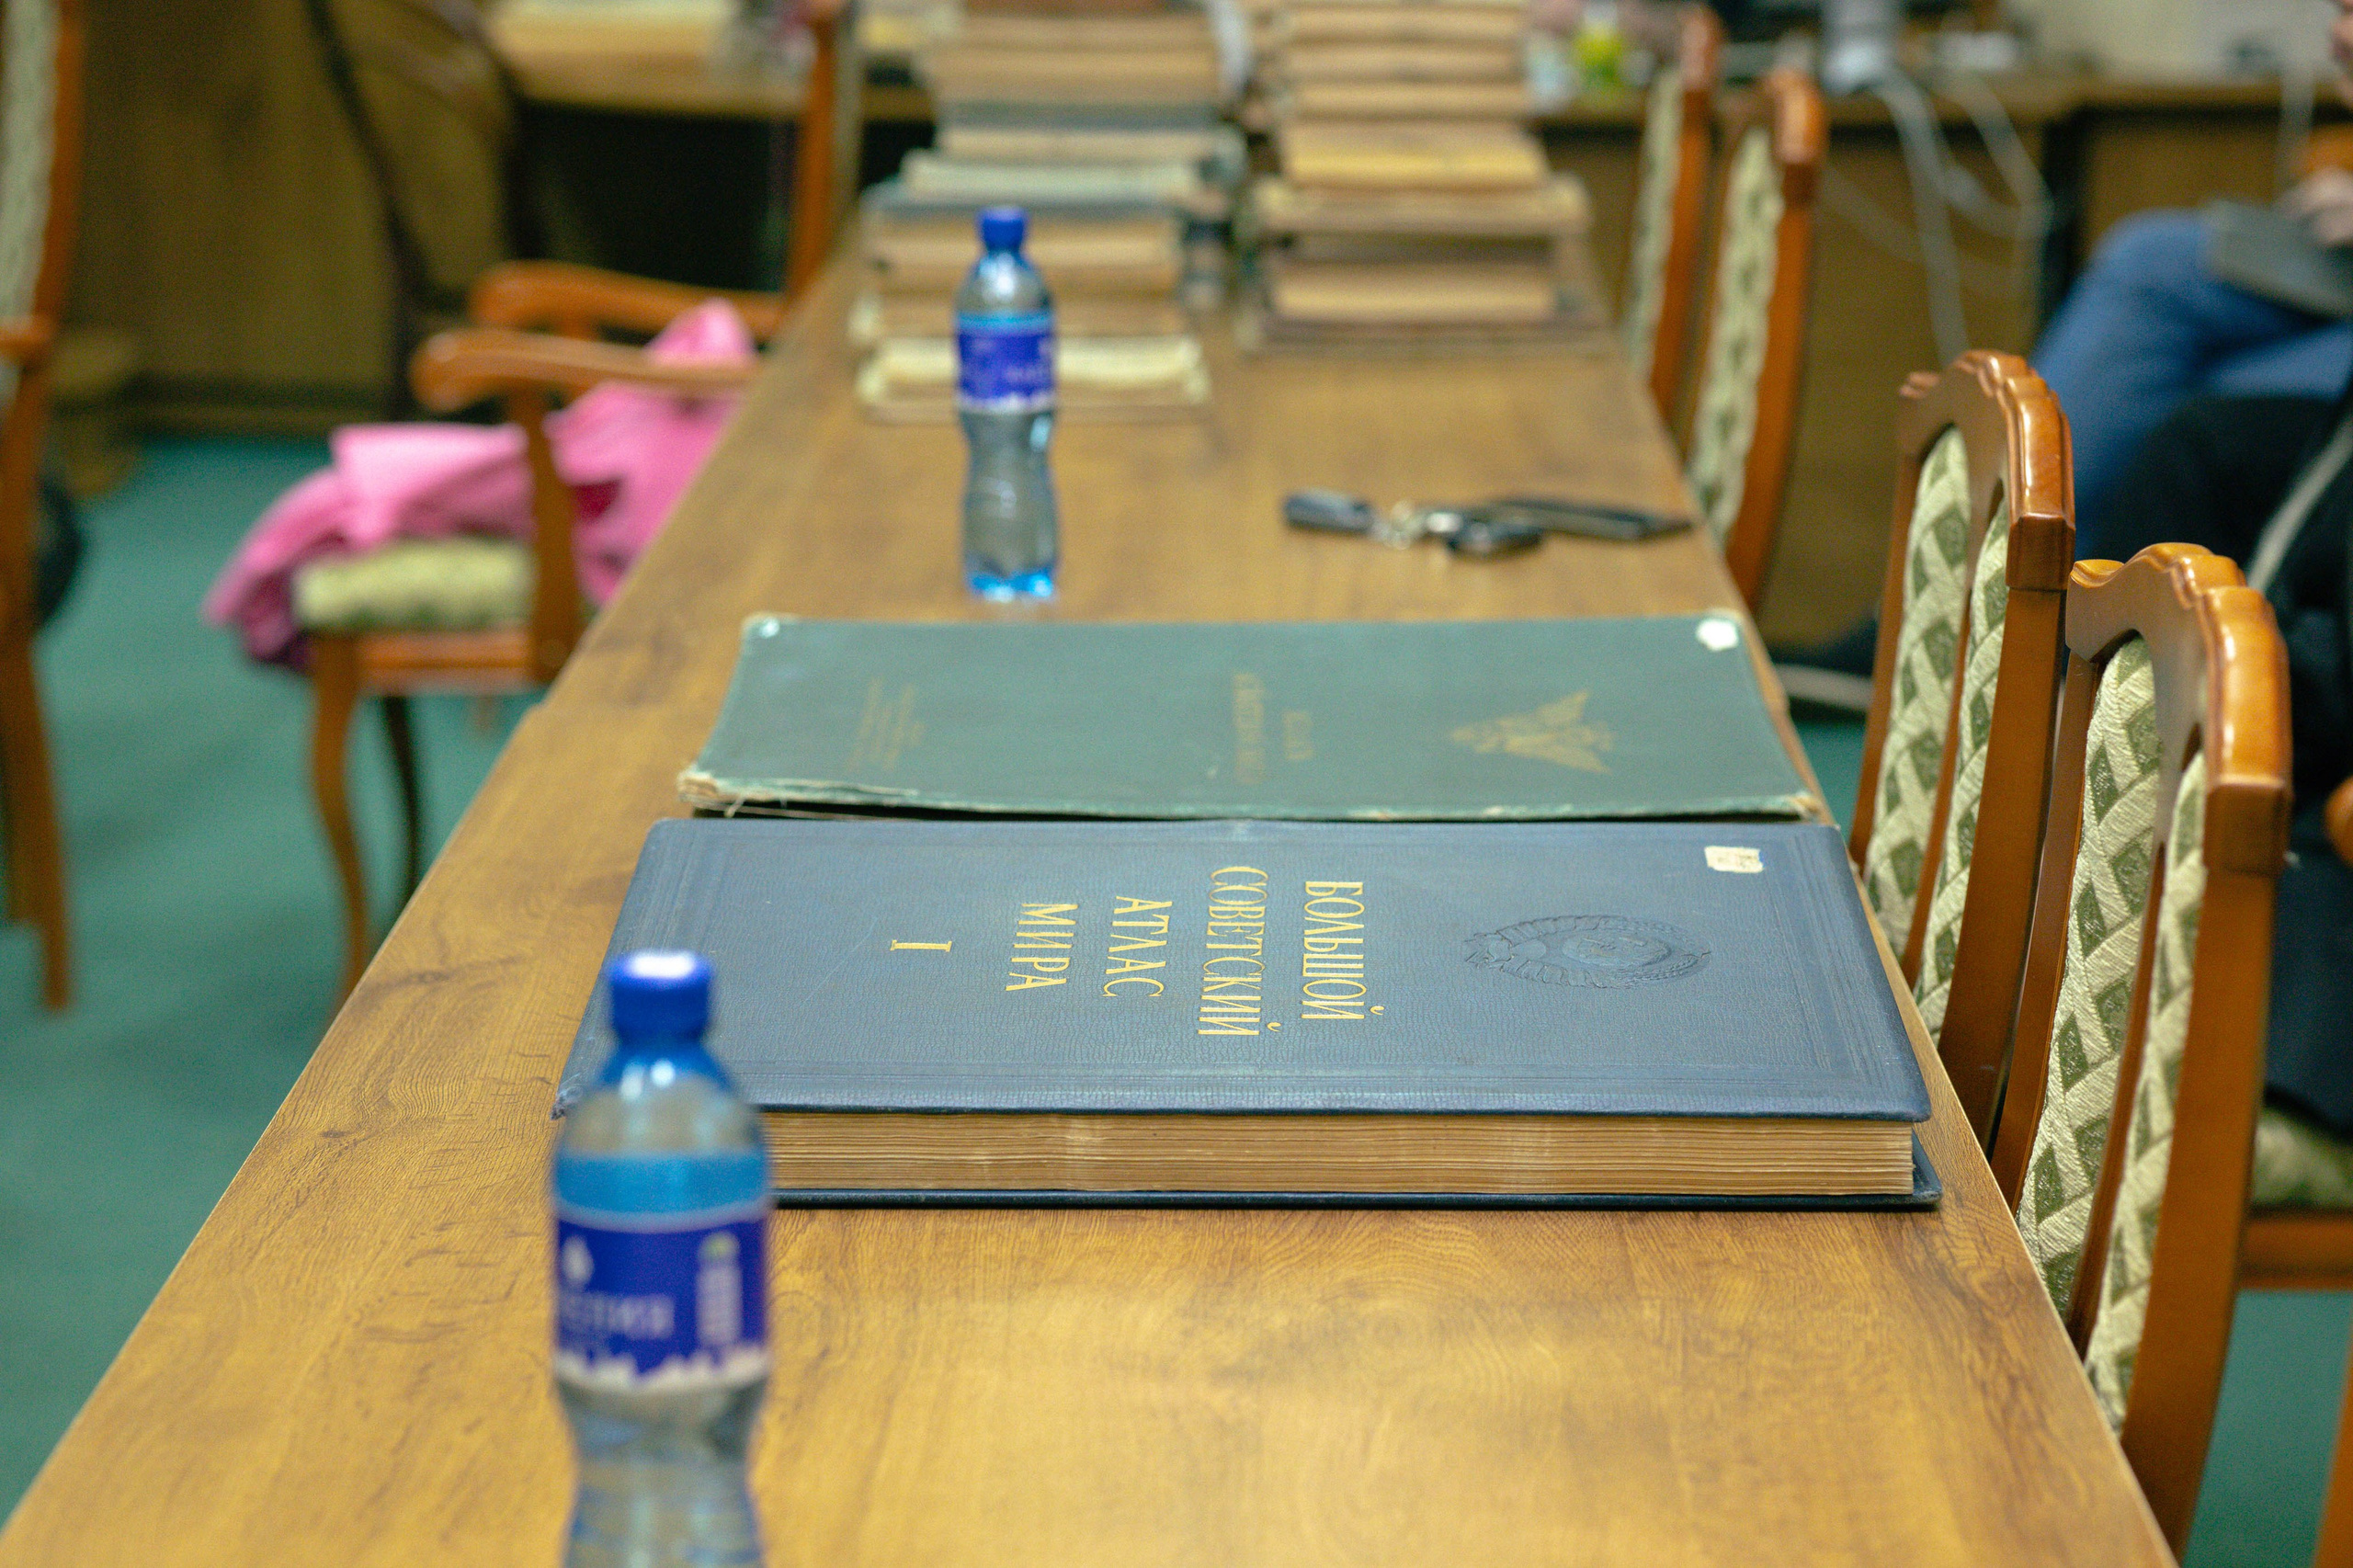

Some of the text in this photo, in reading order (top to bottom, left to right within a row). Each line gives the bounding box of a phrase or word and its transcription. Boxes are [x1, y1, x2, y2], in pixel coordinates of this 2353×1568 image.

[890, 939, 953, 953] I
[1006, 903, 1079, 993] МИРА
[1102, 895, 1174, 998] АТЛАС
[1198, 865, 1282, 1037] СОВЕТСКИЙ
[1301, 881, 1386, 1021] БОЛЬШОЙ
